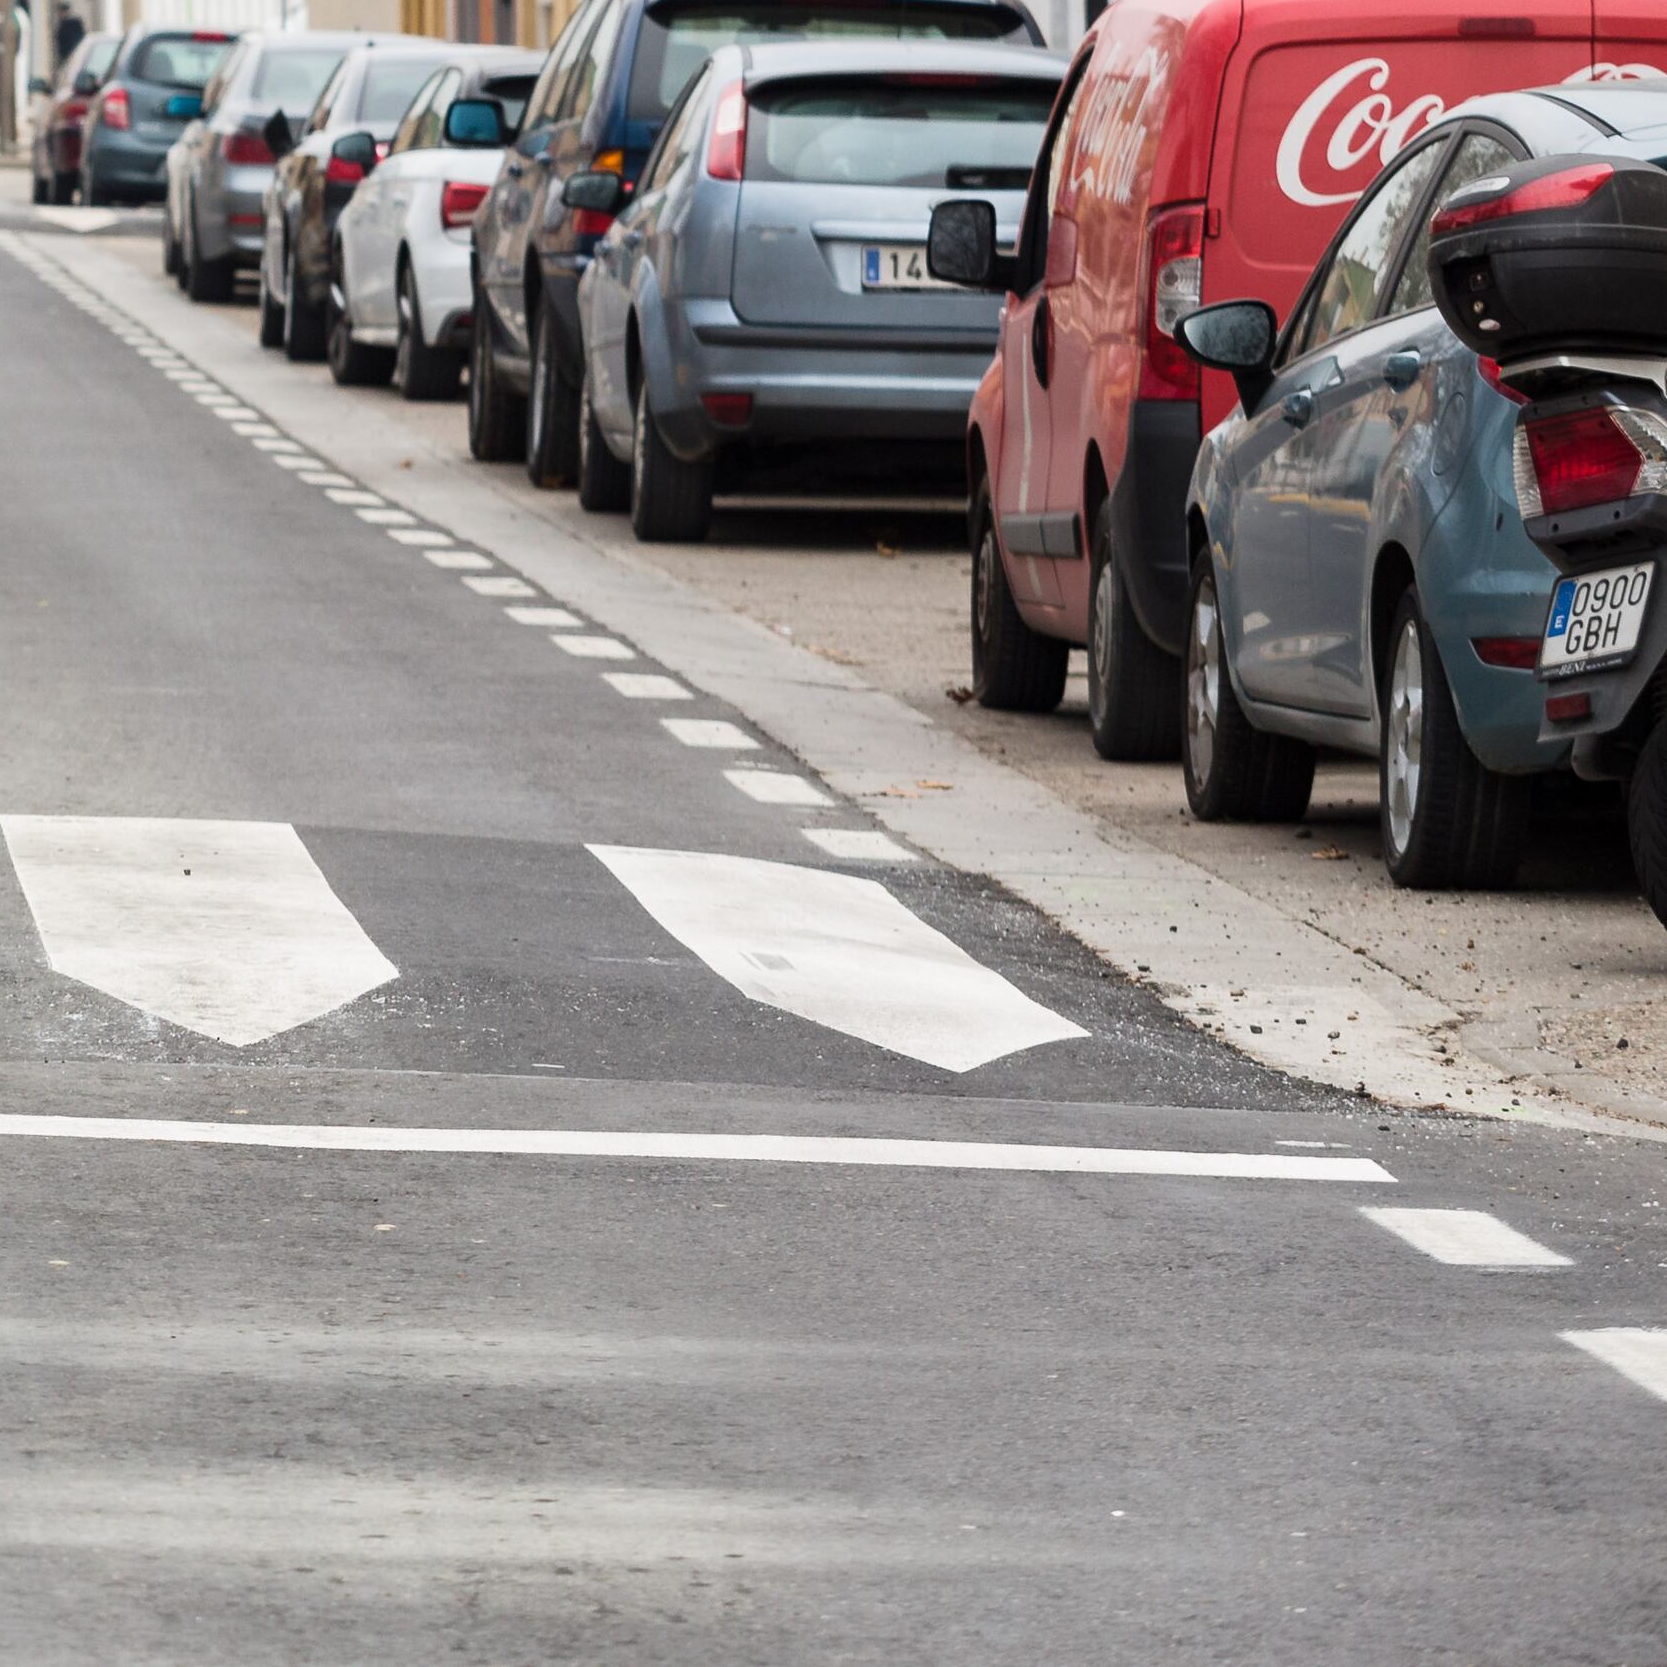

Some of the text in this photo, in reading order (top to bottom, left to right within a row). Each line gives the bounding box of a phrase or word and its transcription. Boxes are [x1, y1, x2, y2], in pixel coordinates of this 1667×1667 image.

[1276, 57, 1445, 207] Coc
[890, 251, 922, 281] 14
[1571, 571, 1648, 617] 0900
[1554, 614, 1565, 629] E
[1564, 611, 1623, 655] GBH
